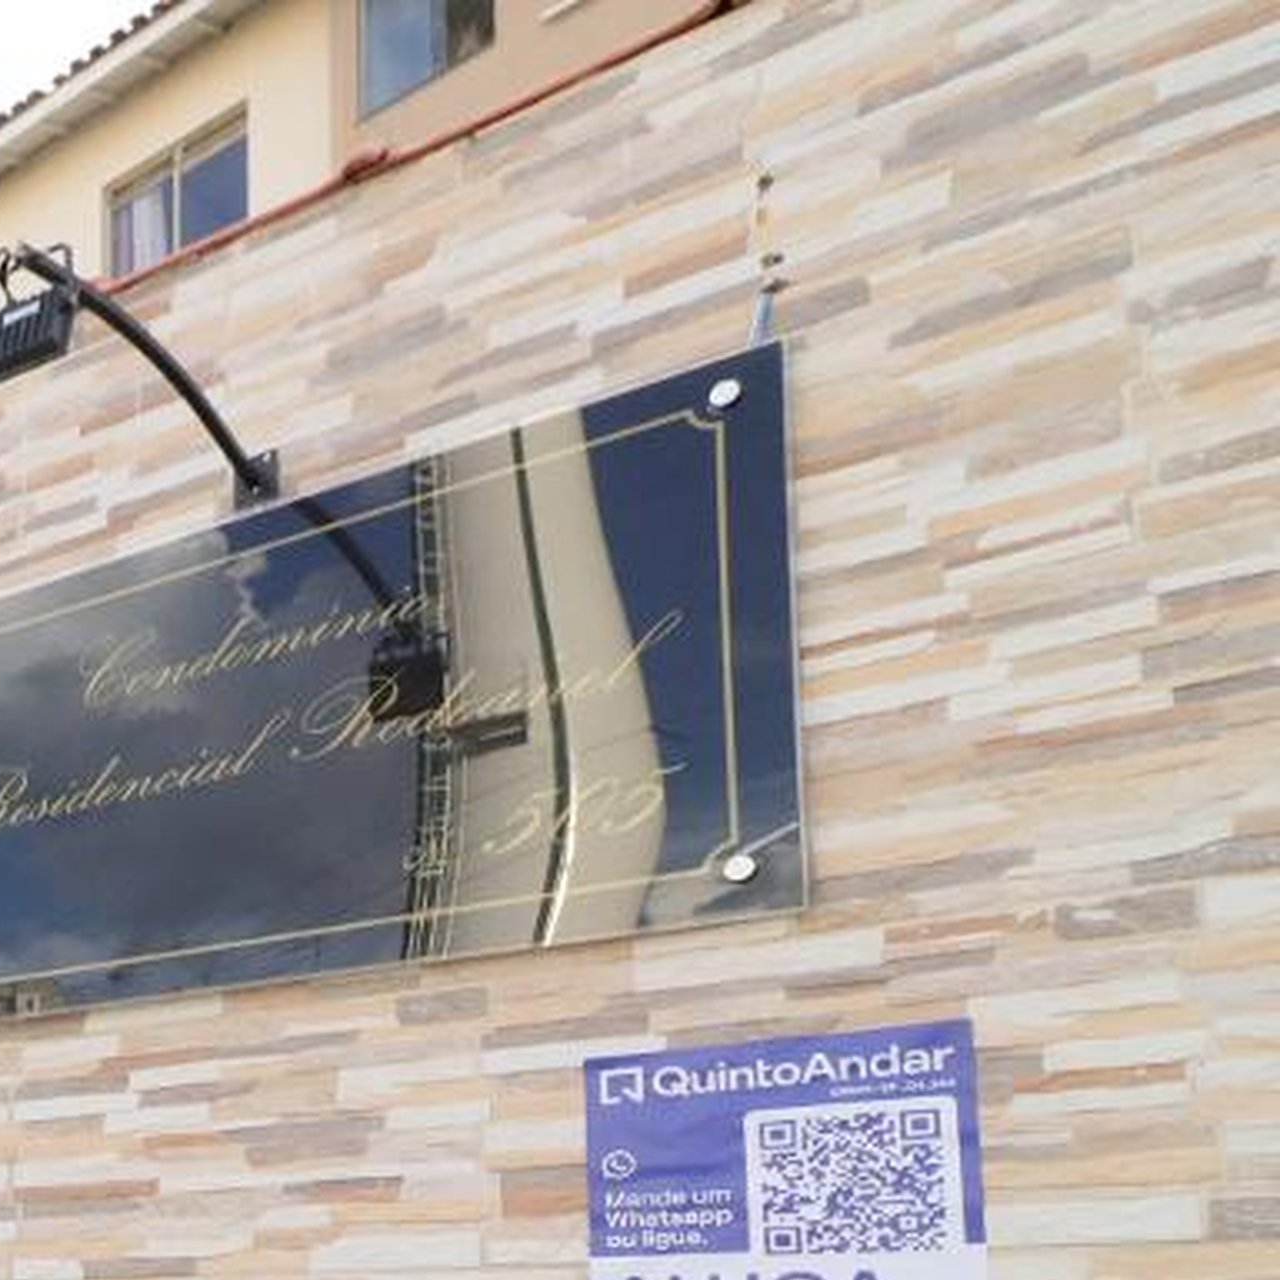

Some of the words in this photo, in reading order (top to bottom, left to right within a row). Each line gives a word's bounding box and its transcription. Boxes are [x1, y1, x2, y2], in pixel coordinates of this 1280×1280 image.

[652, 1044, 956, 1098] QuintoAndar
[604, 1188, 687, 1208] Mande
[691, 1189, 733, 1205] um
[605, 1234, 637, 1248] ou
[641, 1229, 709, 1251] ligue.
